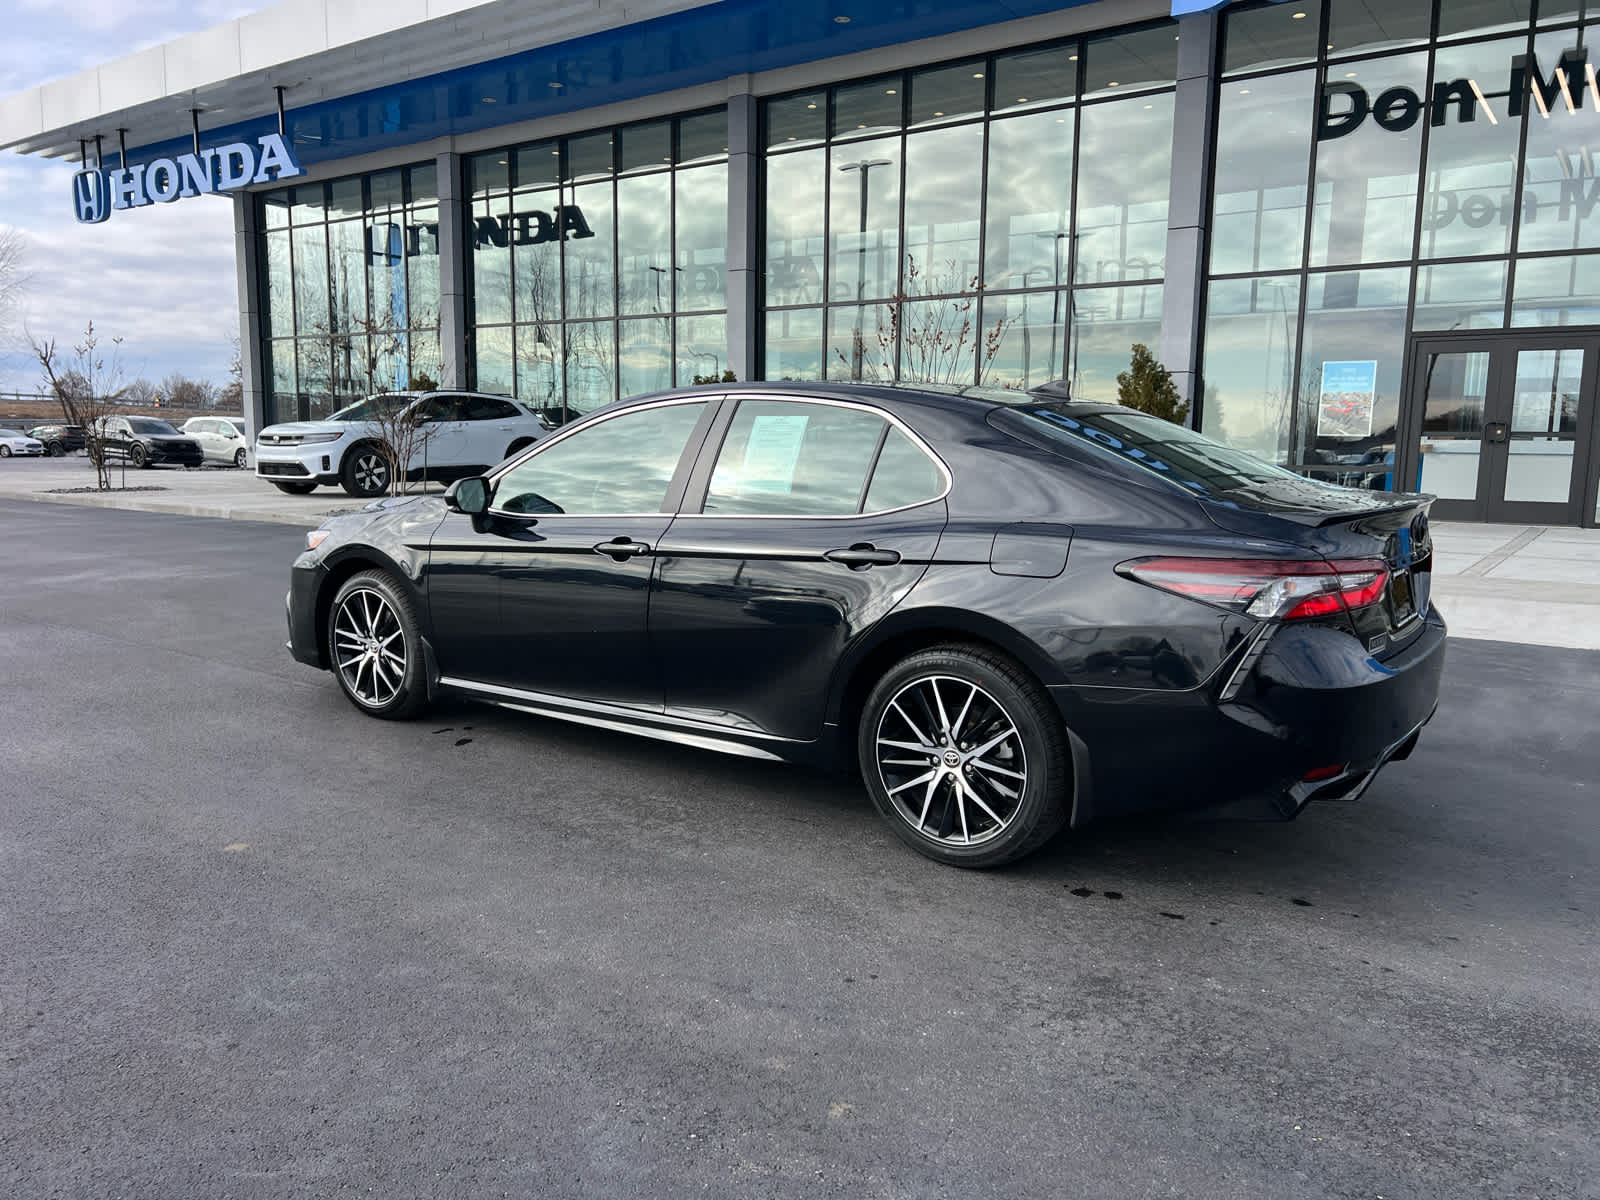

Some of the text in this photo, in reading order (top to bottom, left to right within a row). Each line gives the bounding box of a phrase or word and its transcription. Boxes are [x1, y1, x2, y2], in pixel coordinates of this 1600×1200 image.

[1317, 46, 1600, 141] Don M
[110, 133, 301, 210] HONDA
